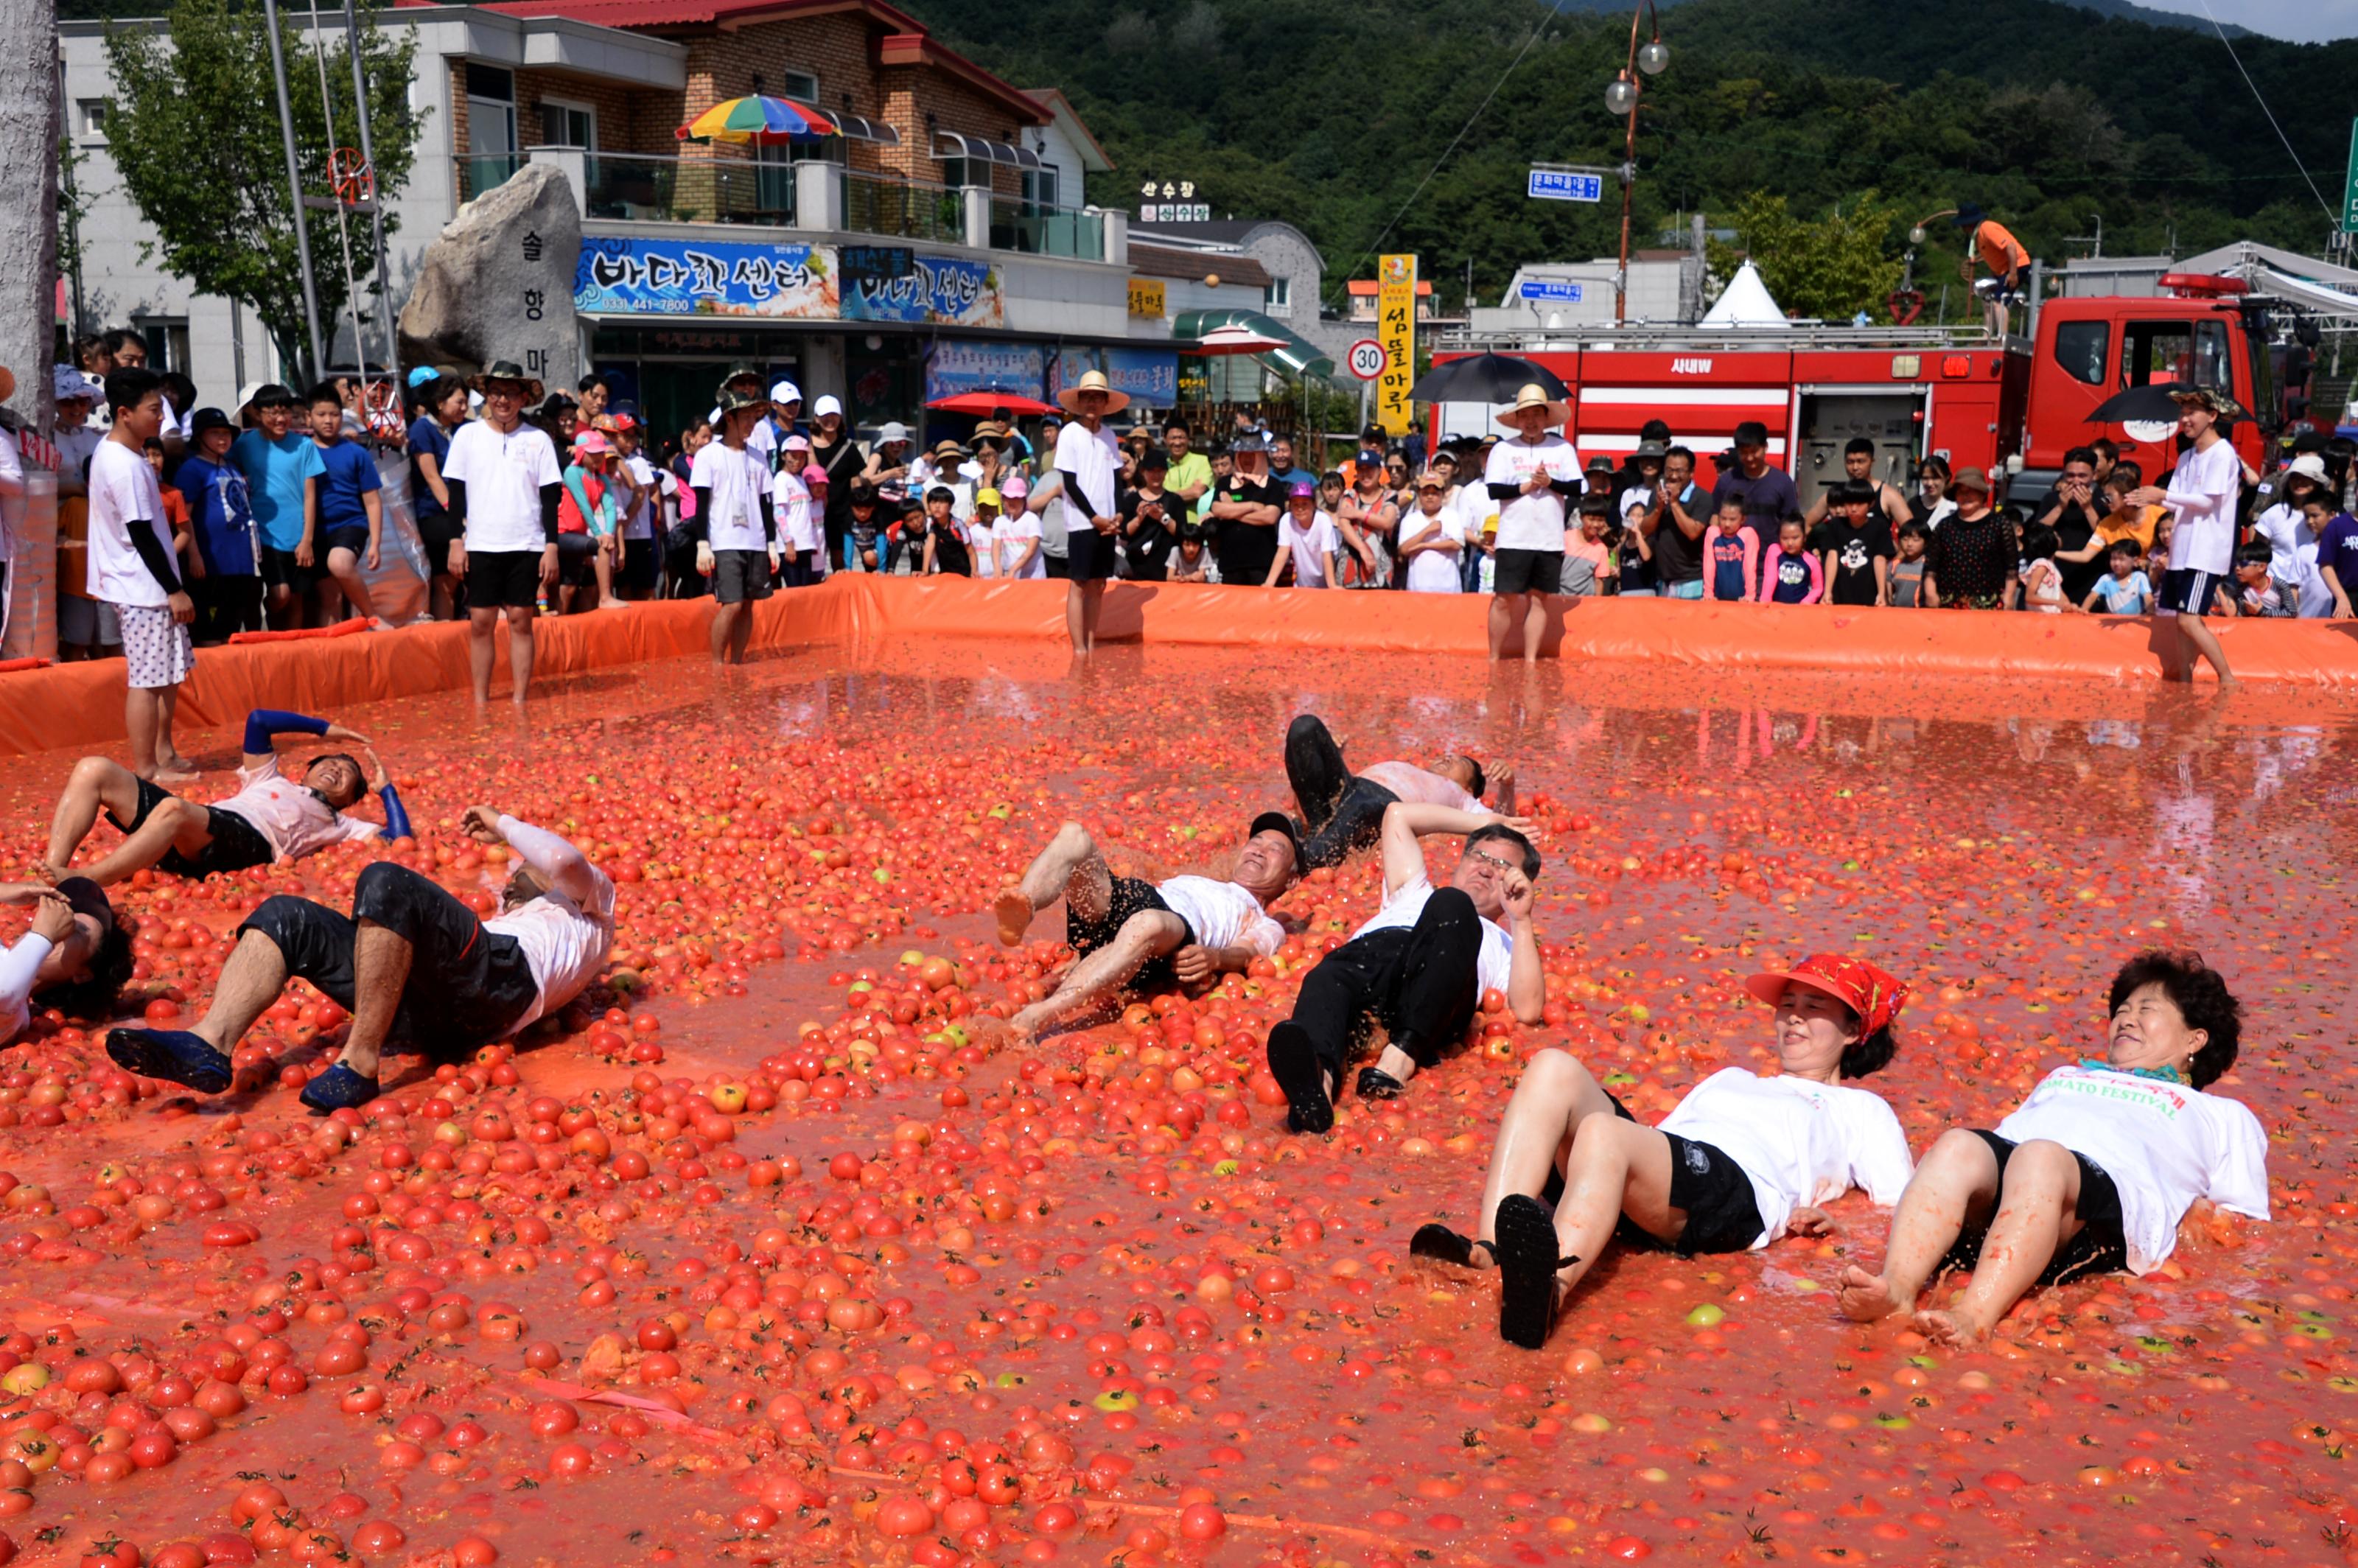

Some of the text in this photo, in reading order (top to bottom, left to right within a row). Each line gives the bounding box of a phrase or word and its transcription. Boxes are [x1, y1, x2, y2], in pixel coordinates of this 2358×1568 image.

[1357, 349, 1378, 369] 30
[2038, 1078, 2097, 1094] OMATO
[2100, 1085, 2177, 1121] FESTIVAL
